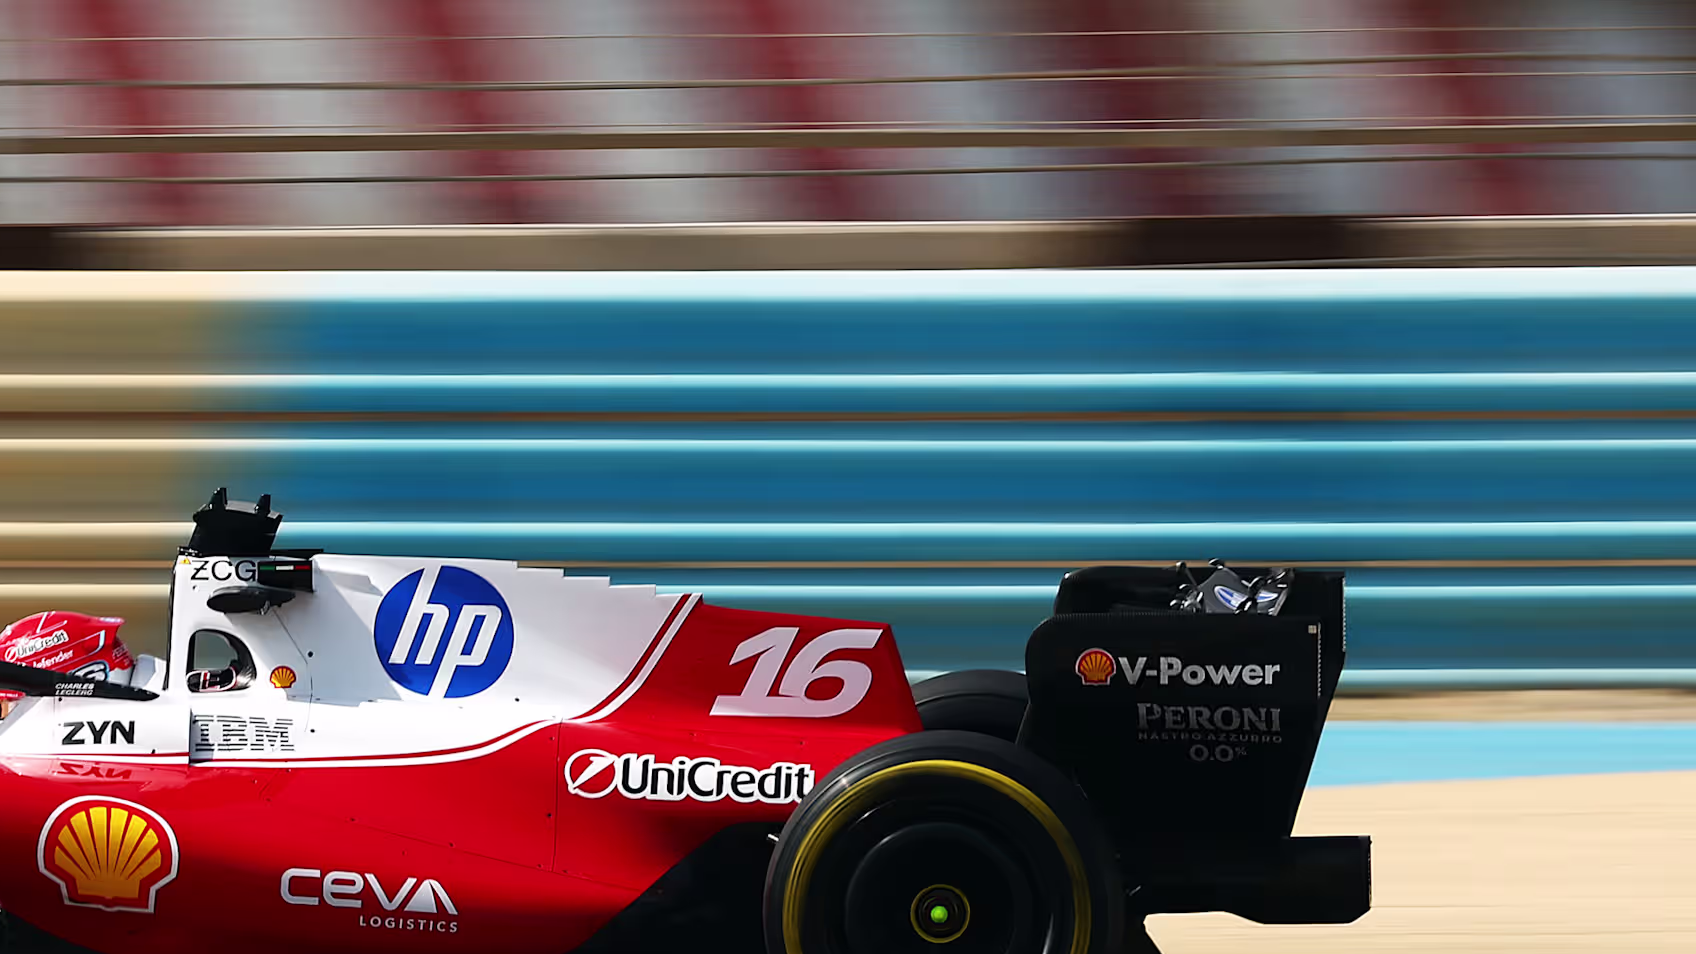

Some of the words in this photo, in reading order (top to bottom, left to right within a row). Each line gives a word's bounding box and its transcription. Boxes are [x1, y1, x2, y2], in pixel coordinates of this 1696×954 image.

[17, 630, 67, 657] UniCredit
[389, 566, 503, 698] hp
[708, 626, 884, 718] 16
[1117, 655, 1281, 686] V-Power
[54, 682, 95, 690] CHARLES
[1136, 702, 1281, 732] PERONI
[61, 720, 135, 745] ZYN
[193, 714, 295, 752] IBM
[620, 757, 811, 799] UniCredit
[359, 915, 458, 933] LOGISTICS
